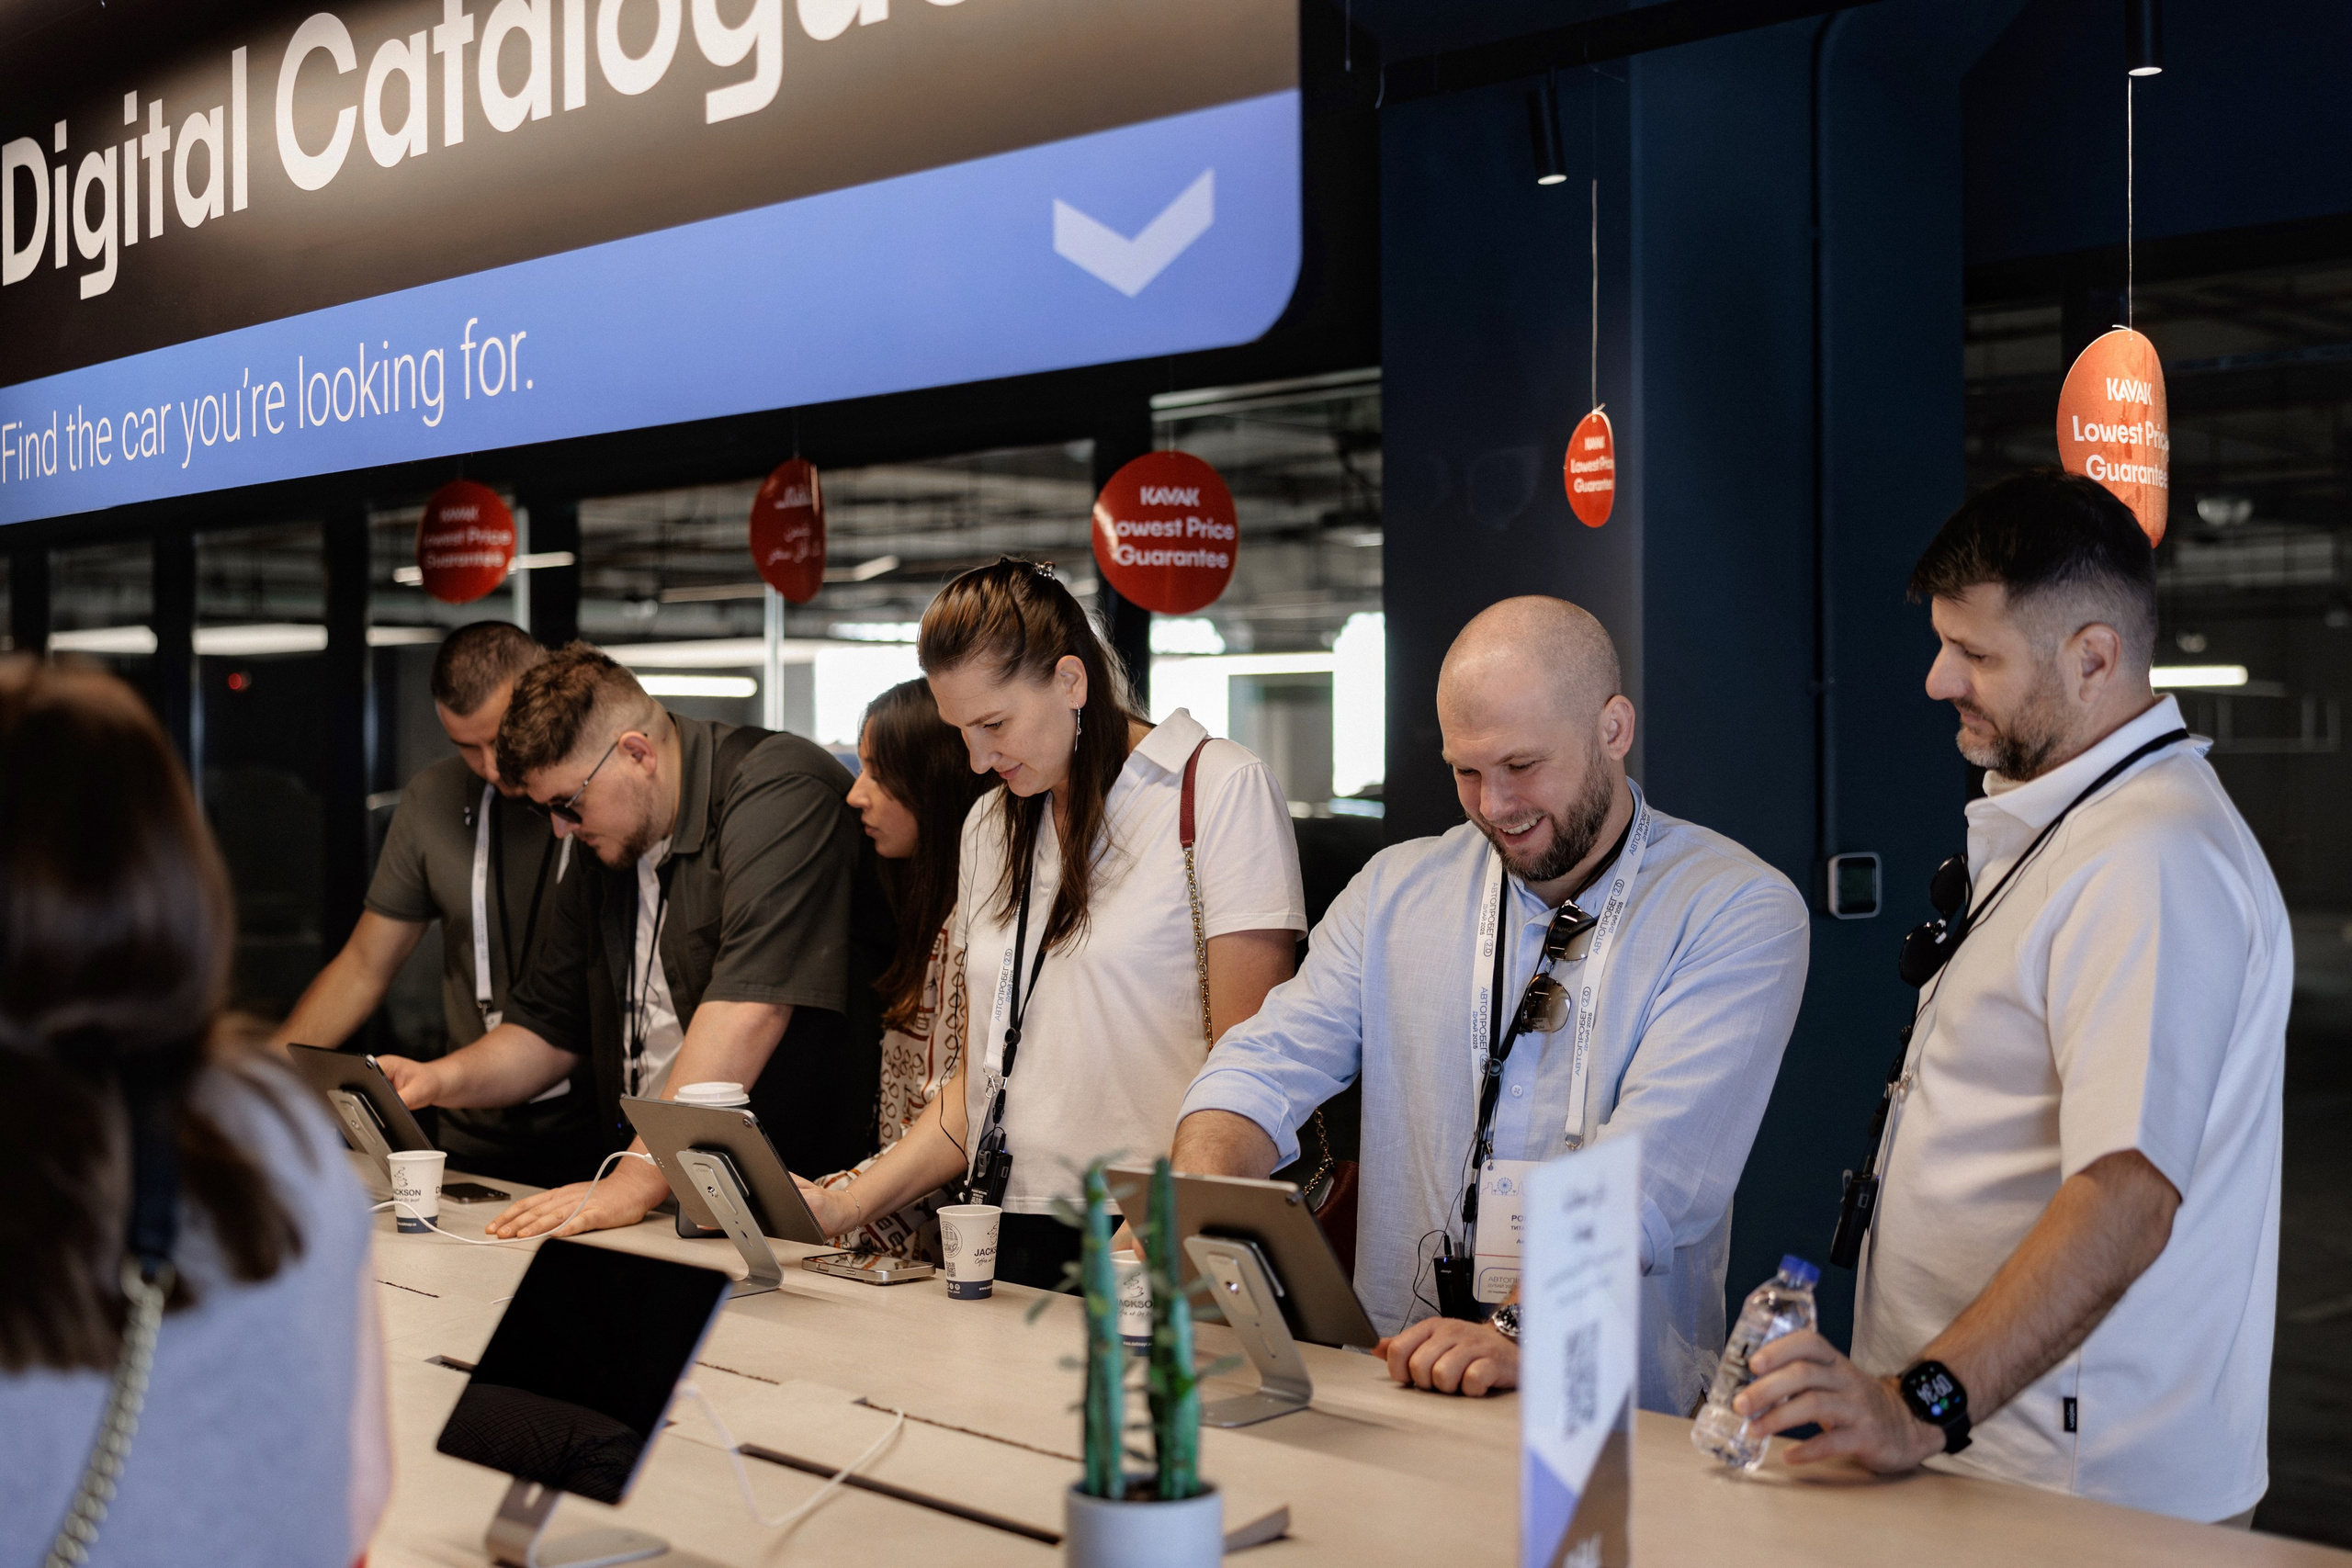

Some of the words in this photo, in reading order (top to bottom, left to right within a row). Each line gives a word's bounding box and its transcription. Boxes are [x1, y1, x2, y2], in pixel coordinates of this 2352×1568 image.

[2, 46, 249, 300] Digital
[276, 0, 972, 191] Catalog
[2, 411, 57, 484] Find
[66, 404, 112, 470] the
[121, 403, 172, 461] car
[299, 341, 445, 428] looking
[460, 318, 534, 400] for.
[2106, 378, 2153, 406] KAVAK
[2072, 415, 2143, 446] Lowest
[1140, 486, 1200, 507] KAVAK
[1107, 519, 1182, 538] owest
[1186, 516, 1236, 541] Price
[1115, 544, 1229, 569] Guarantee
[1487, 882, 1498, 939] АВТОПРОБЕГ
[1593, 896, 1619, 954] АВТОПРОБЕГ
[995, 966, 1010, 1021] АВТОПРОБЕГ
[1478, 986, 1488, 1053] АВТОПРОБЕГ
[1575, 1008, 1587, 1077] АВТОПРОБЕГ
[393, 1189, 422, 1197] CKSON
[974, 1246, 997, 1257] JACKS
